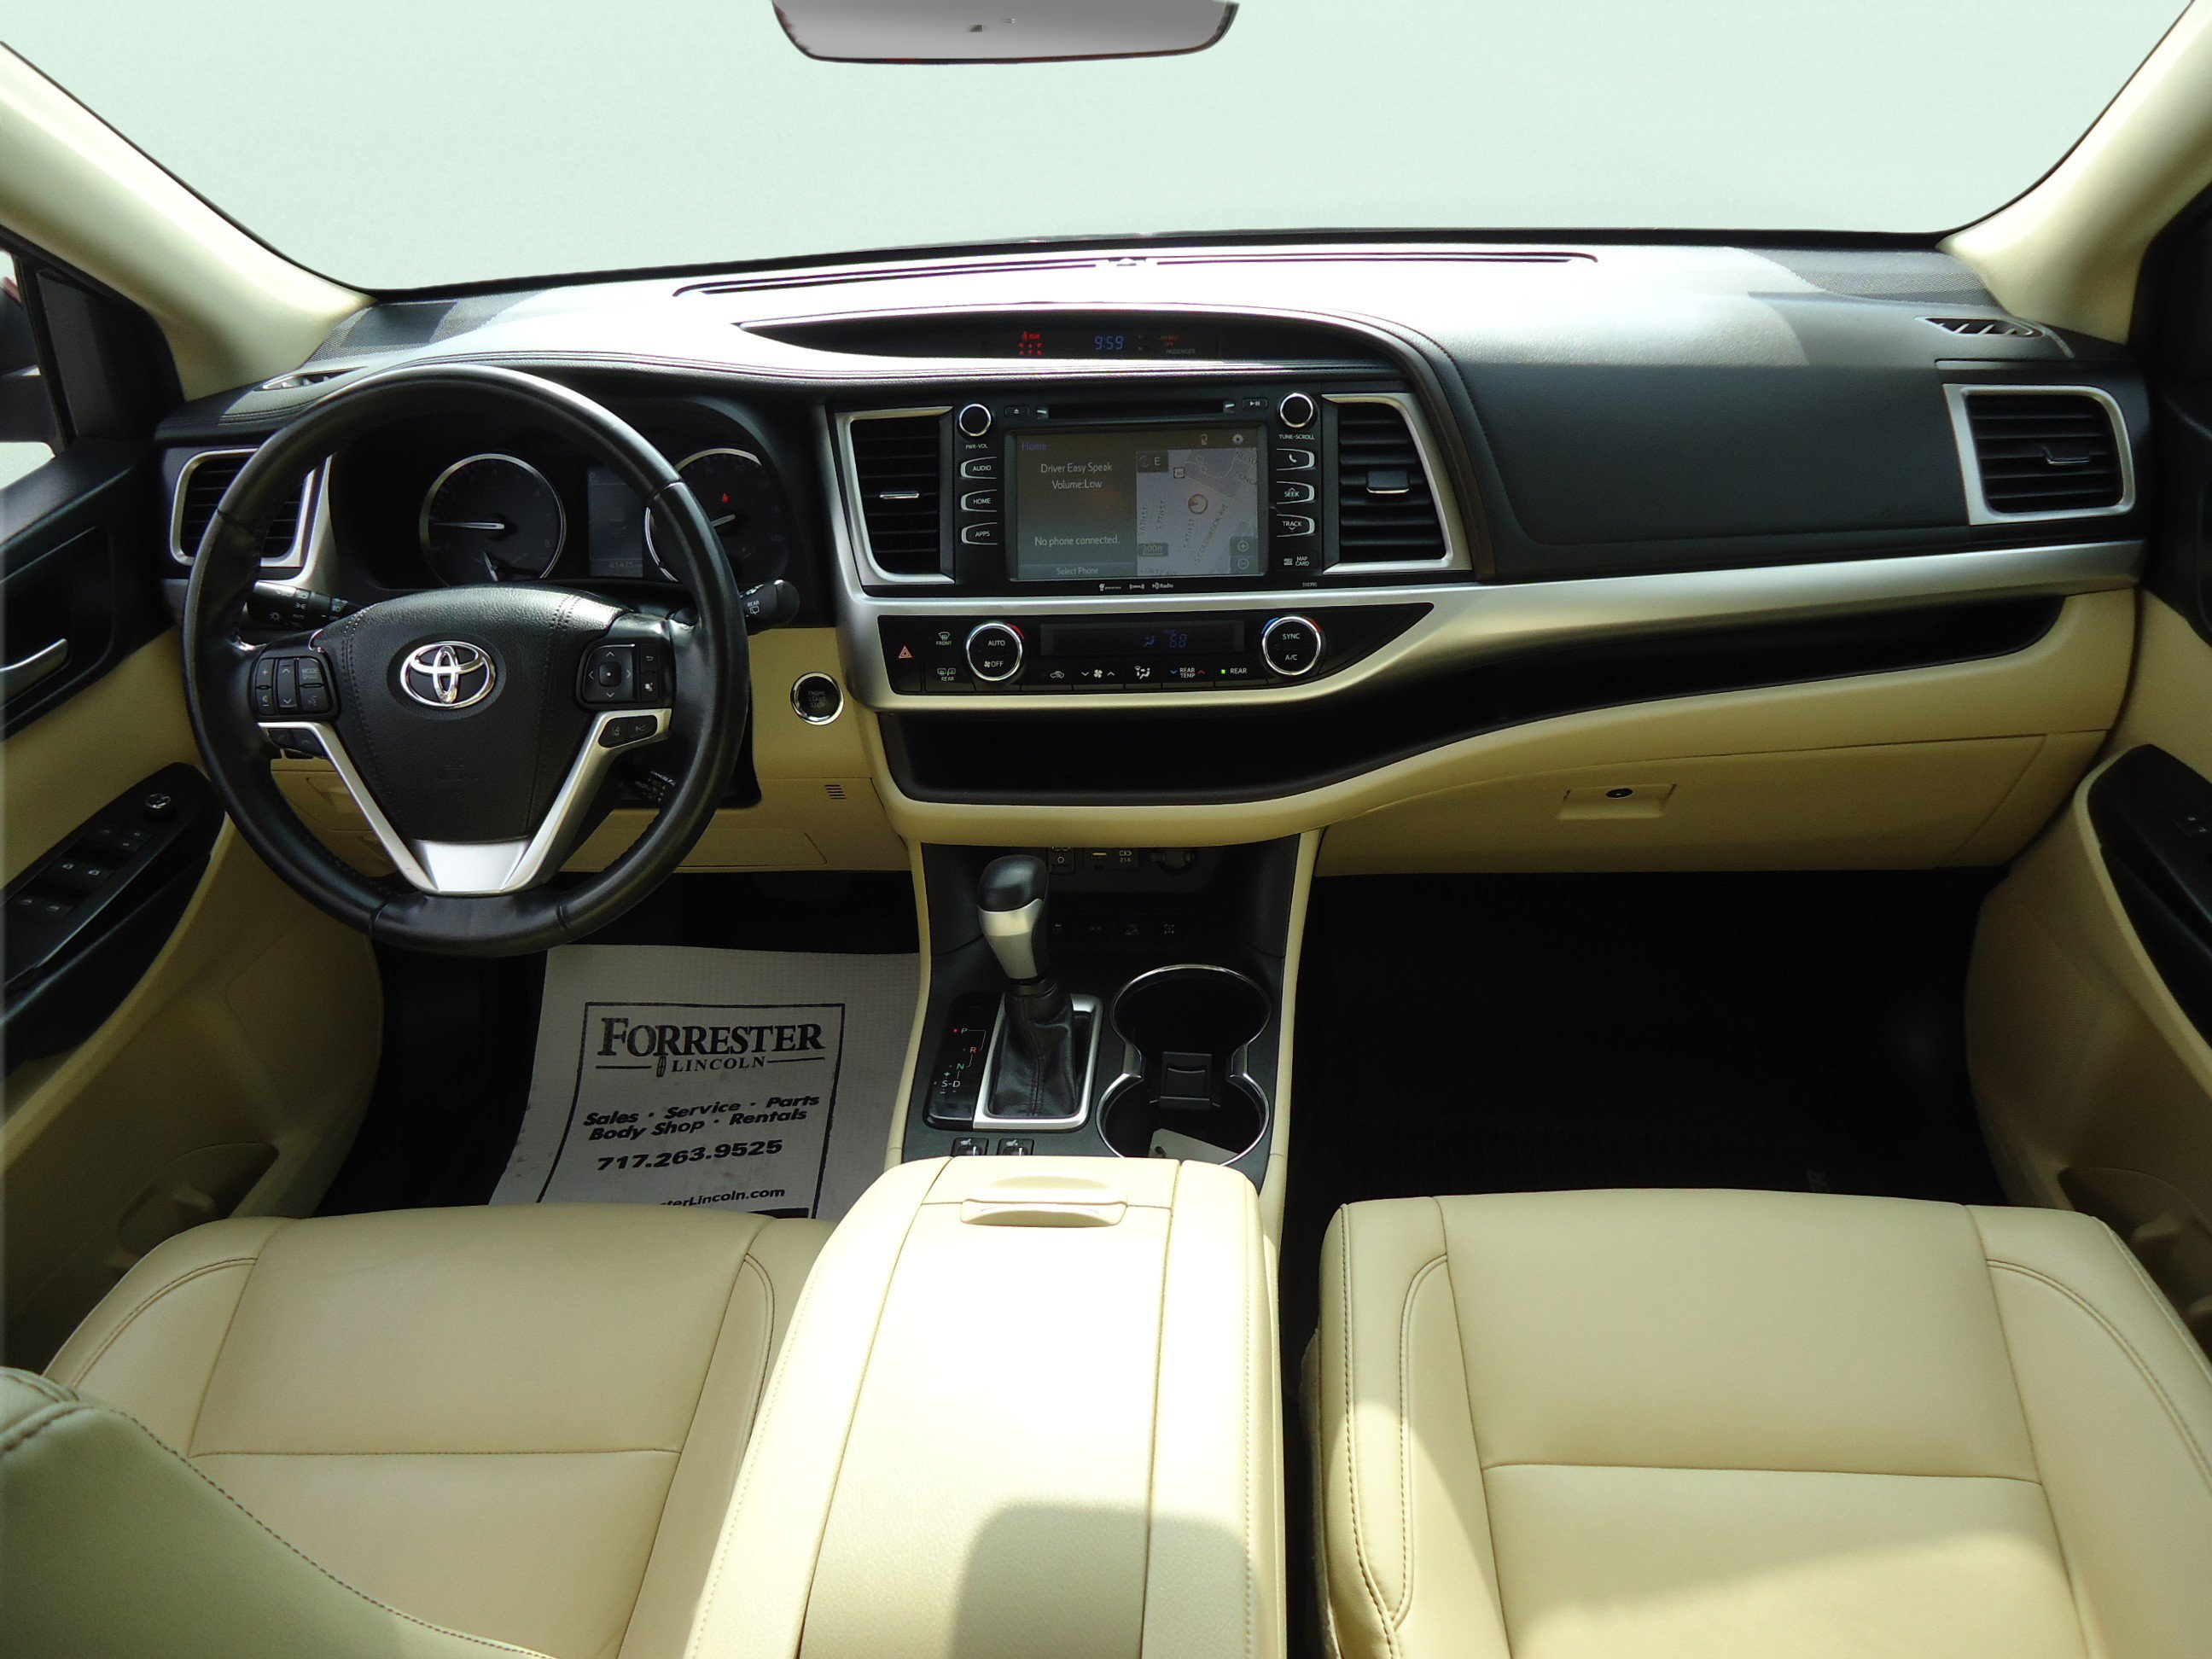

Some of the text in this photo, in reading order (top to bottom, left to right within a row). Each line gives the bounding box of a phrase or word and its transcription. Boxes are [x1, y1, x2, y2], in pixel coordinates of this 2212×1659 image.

[1022, 442, 1047, 451] Home
[1040, 463, 1113, 474] Driver Easy Speak
[1154, 457, 1161, 466] E
[1051, 479, 1103, 490] Volume:Low
[1034, 535, 1121, 547] No phone connected.
[1078, 567, 1099, 575] Phone
[597, 1017, 826, 1057] FORRESTER
[672, 1057, 767, 1073] LINCOLN
[583, 1095, 820, 1126] Sales Service Parts
[589, 1108, 808, 1141] Body Shop Rentals
[597, 1139, 783, 1171] 717.263.9525
[661, 1188, 786, 1207] terLincoln.com
